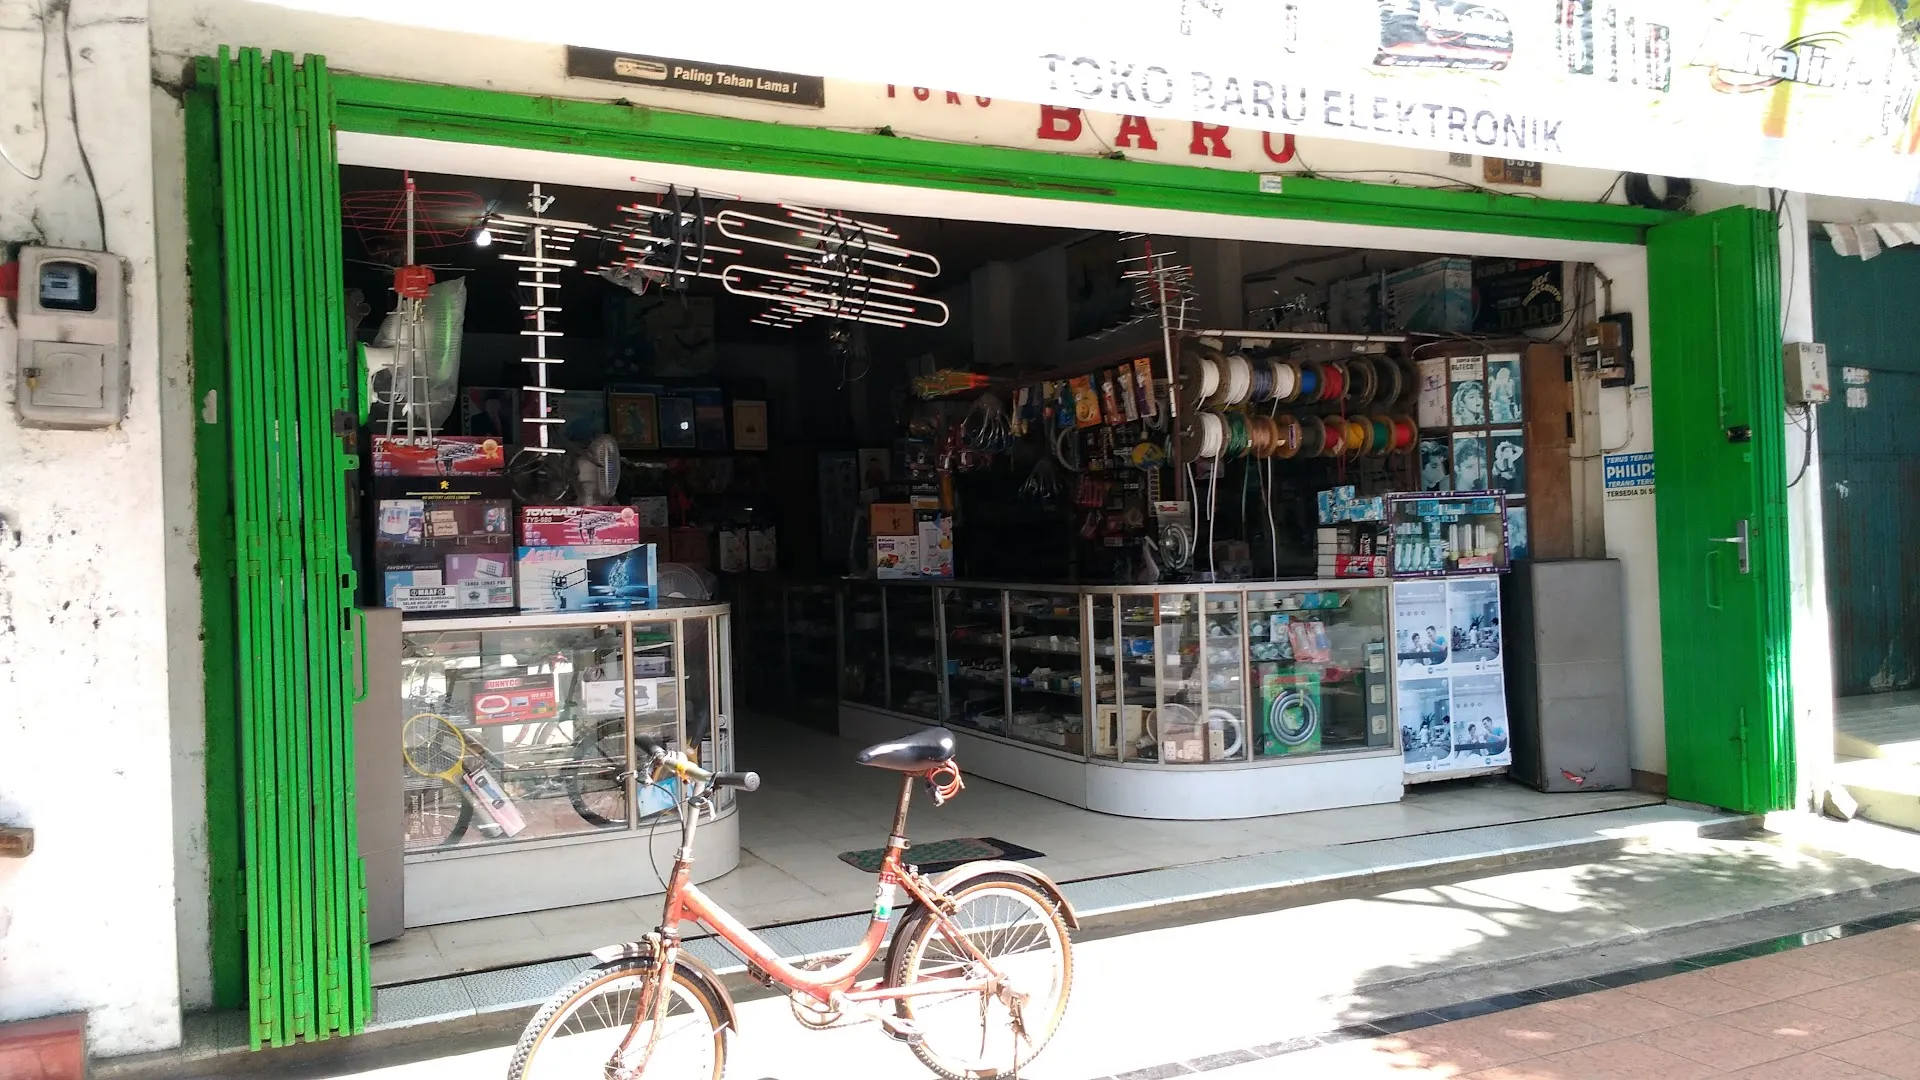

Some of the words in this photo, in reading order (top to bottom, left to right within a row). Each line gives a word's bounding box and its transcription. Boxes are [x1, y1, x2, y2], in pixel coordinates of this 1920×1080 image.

[673, 66, 713, 85] Paling
[716, 72, 753, 89] Tahan
[757, 78, 790, 93] Lama
[1038, 53, 1173, 109] TOKO
[1190, 71, 1306, 126] BARU
[1323, 89, 1563, 153] ELEKTRONIK
[1038, 103, 1297, 164] BARU
[1606, 489, 1638, 497] TERSEDIA
[410, 795, 419, 819] Sound
